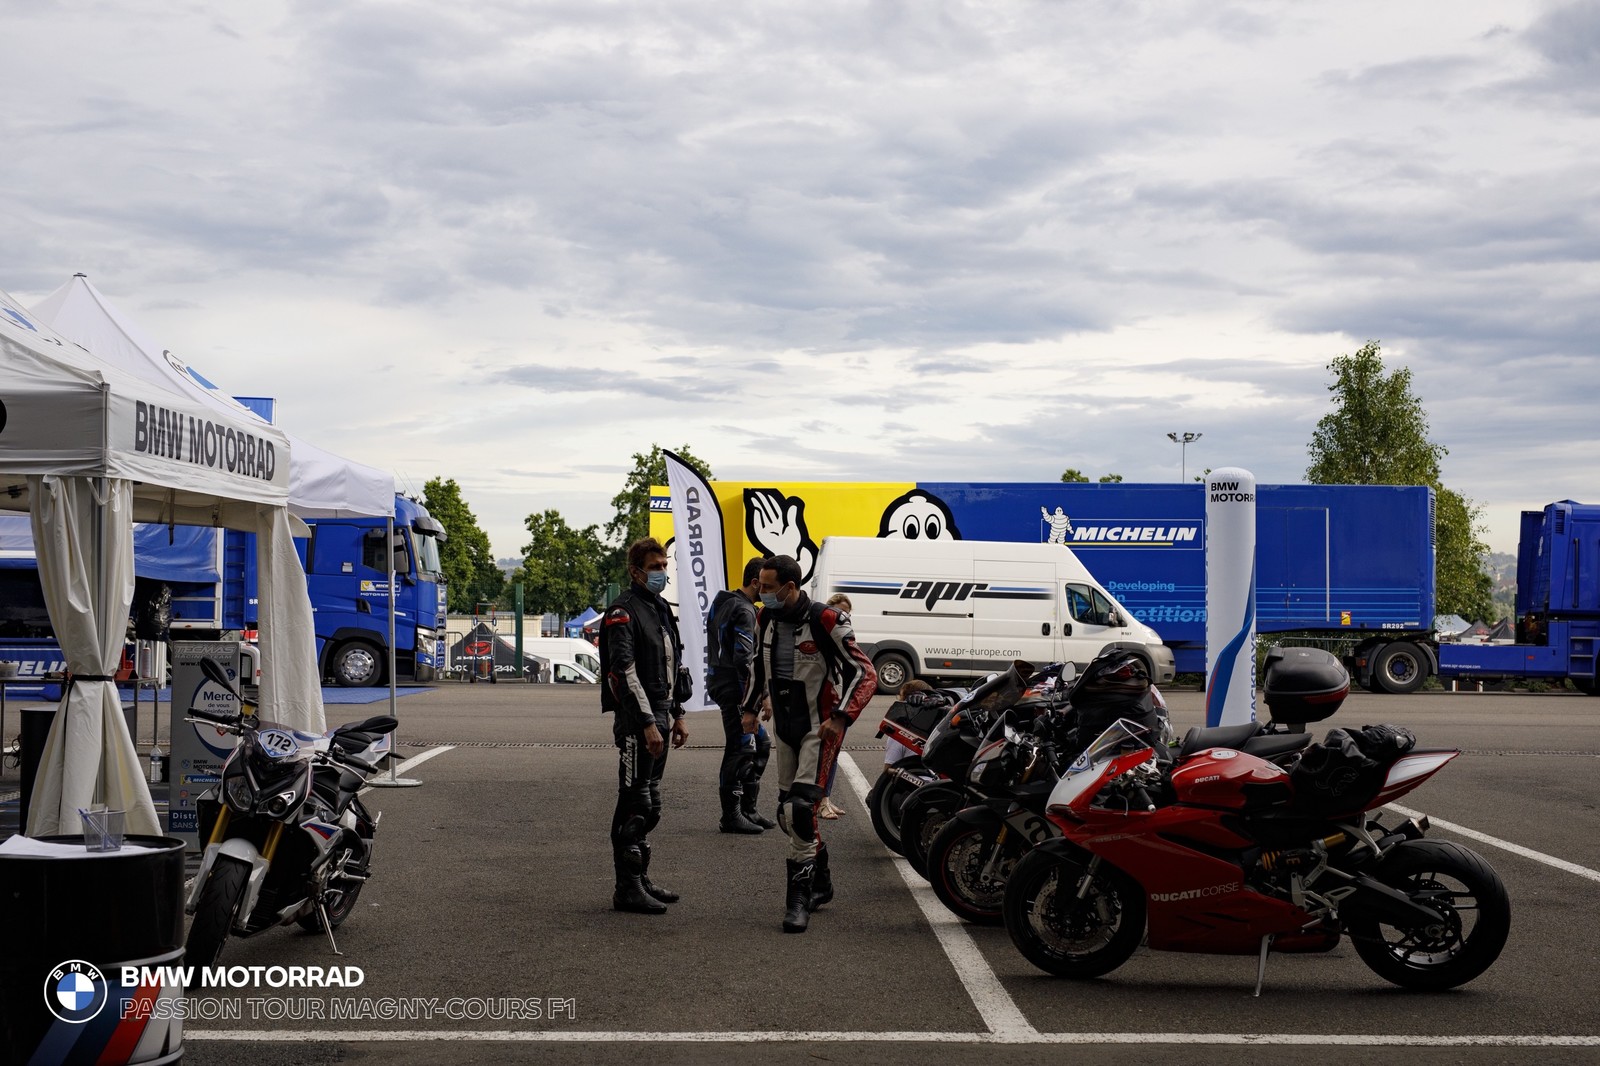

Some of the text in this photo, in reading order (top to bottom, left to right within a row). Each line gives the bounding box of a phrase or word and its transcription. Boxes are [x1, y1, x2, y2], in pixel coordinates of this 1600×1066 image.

[135, 399, 276, 481] BMW MOTORRAD
[1211, 482, 1239, 491] BMW
[1211, 493, 1256, 503] MOTORR
[1073, 526, 1197, 541] MICHELIN
[1109, 581, 1175, 592] Developing
[900, 581, 988, 612] apr
[1132, 605, 1208, 623] etition
[174, 645, 236, 655] TECMAS
[925, 646, 1021, 659] www.apr-europe.com
[204, 691, 235, 701] Merci
[268, 733, 292, 751] 172
[1195, 776, 1221, 784] DUCATI
